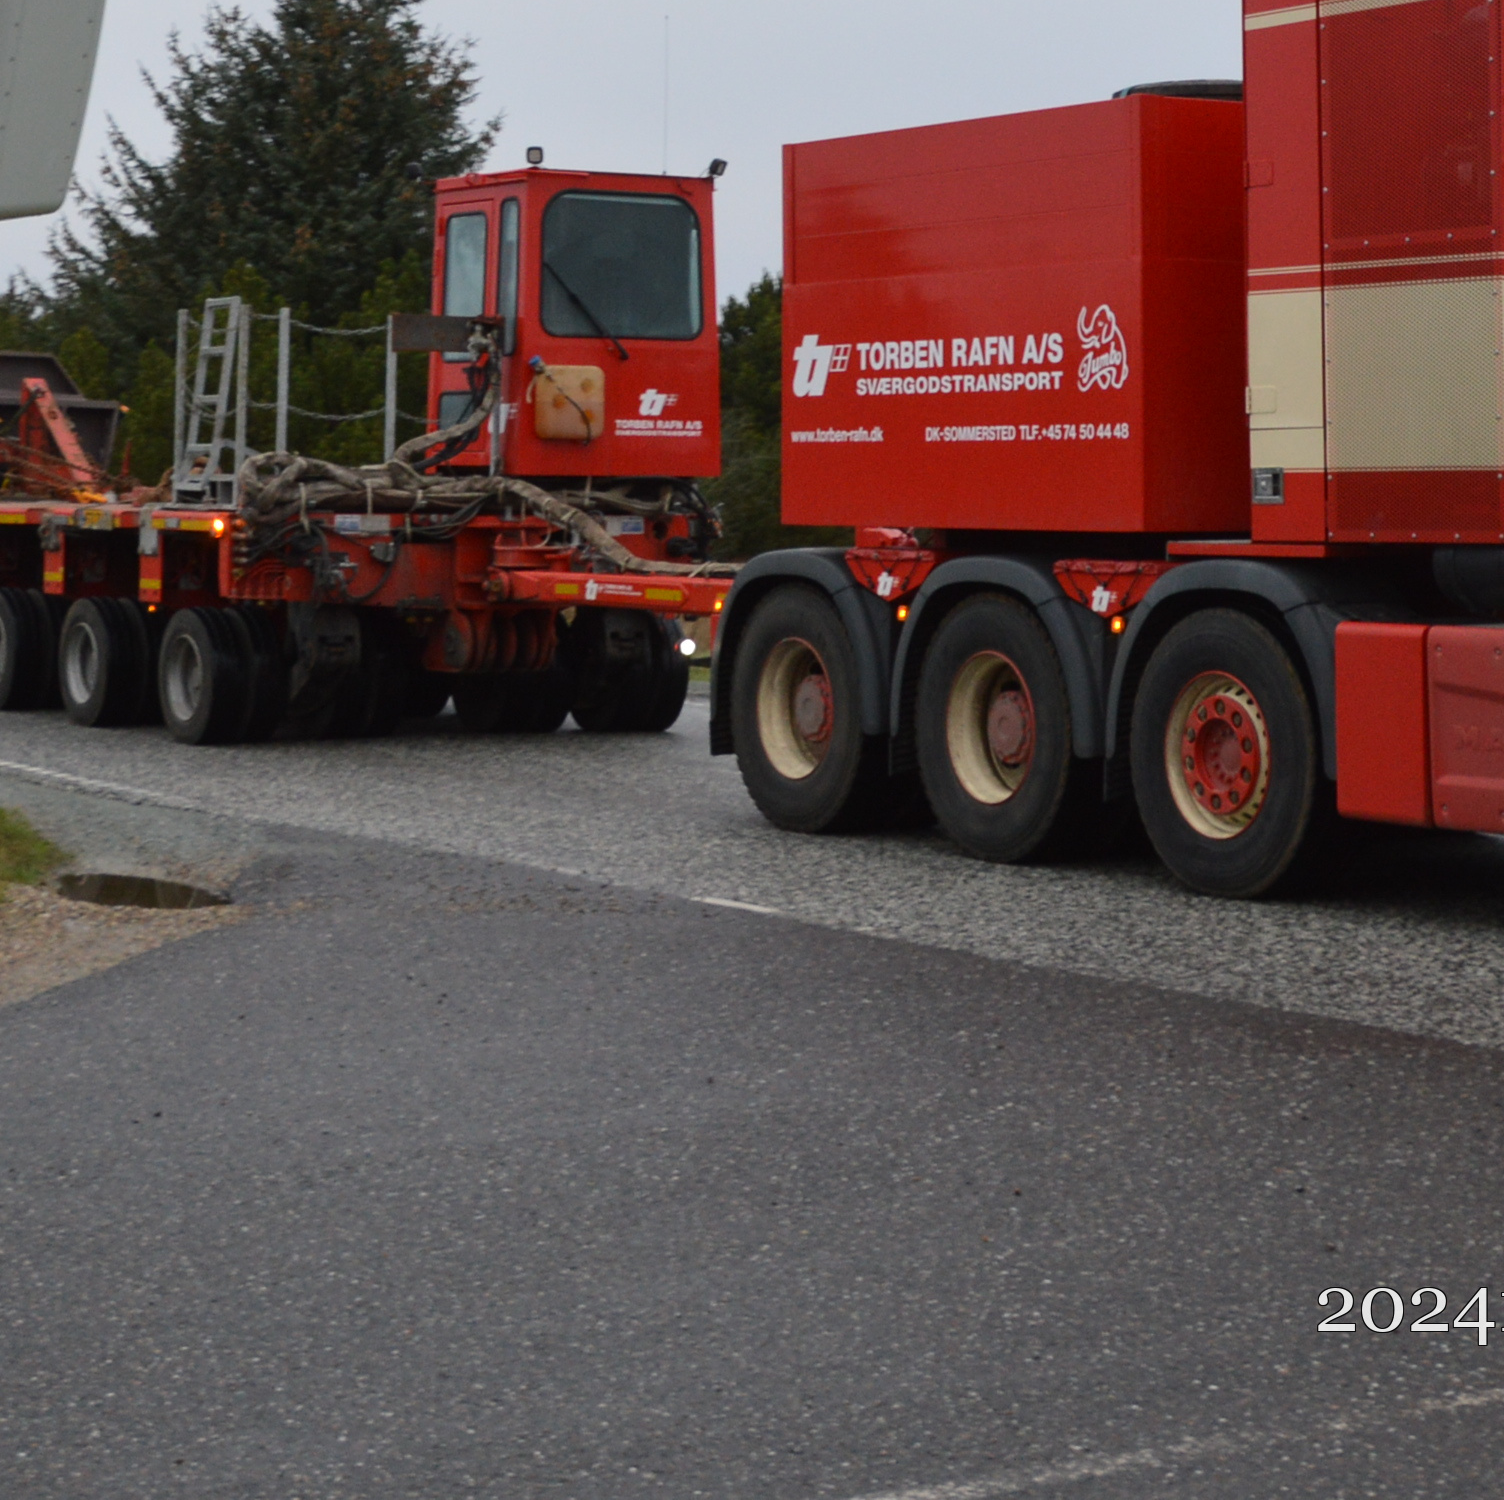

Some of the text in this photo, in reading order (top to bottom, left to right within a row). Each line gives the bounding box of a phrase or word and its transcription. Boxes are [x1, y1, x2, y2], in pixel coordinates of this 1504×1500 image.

[856, 332, 1064, 371] TORBEN RAFN A/S
[855, 371, 1064, 396] SVÆRGODSTRANSPORT
[791, 427, 884, 443] www.torben-rafn.dk
[925, 424, 1016, 442] DK-SOMMERSTED
[1079, 423, 1095, 440] 50
[1096, 423, 1111, 440] 44
[1113, 422, 1130, 440] 48
